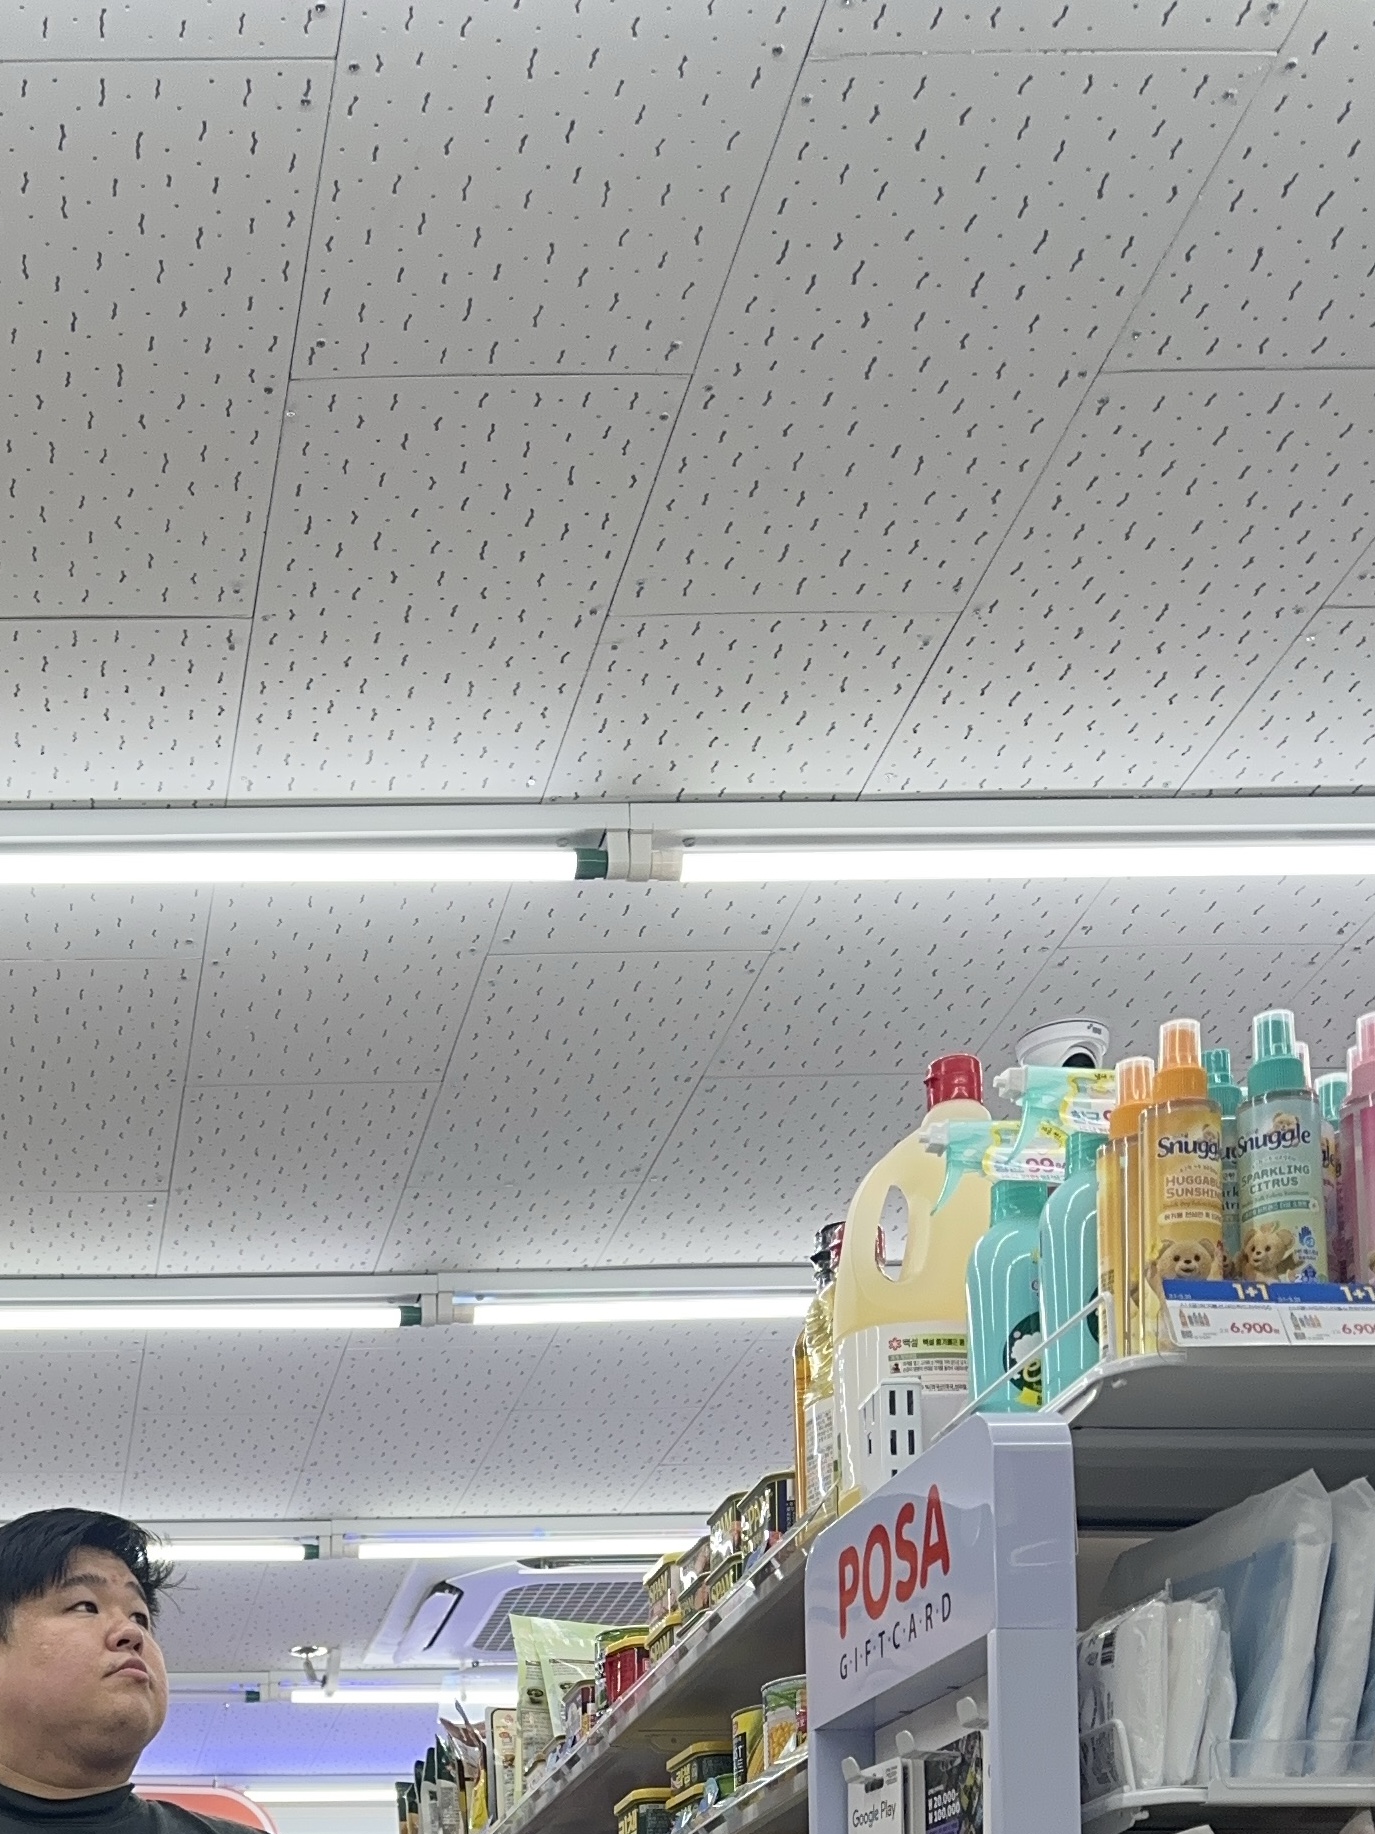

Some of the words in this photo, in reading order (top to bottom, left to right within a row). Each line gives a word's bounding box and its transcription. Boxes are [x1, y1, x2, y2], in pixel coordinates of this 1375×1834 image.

[1238, 1123, 1311, 1158] Snuggle
[1242, 1165, 1310, 1187] SPARKLING
[1250, 1177, 1299, 1195] CITRUS
[1233, 1283, 1269, 1301] 1+1
[837, 1484, 951, 1639] POSA
[853, 1806, 879, 1828] Google
[881, 1800, 896, 1822] Play
